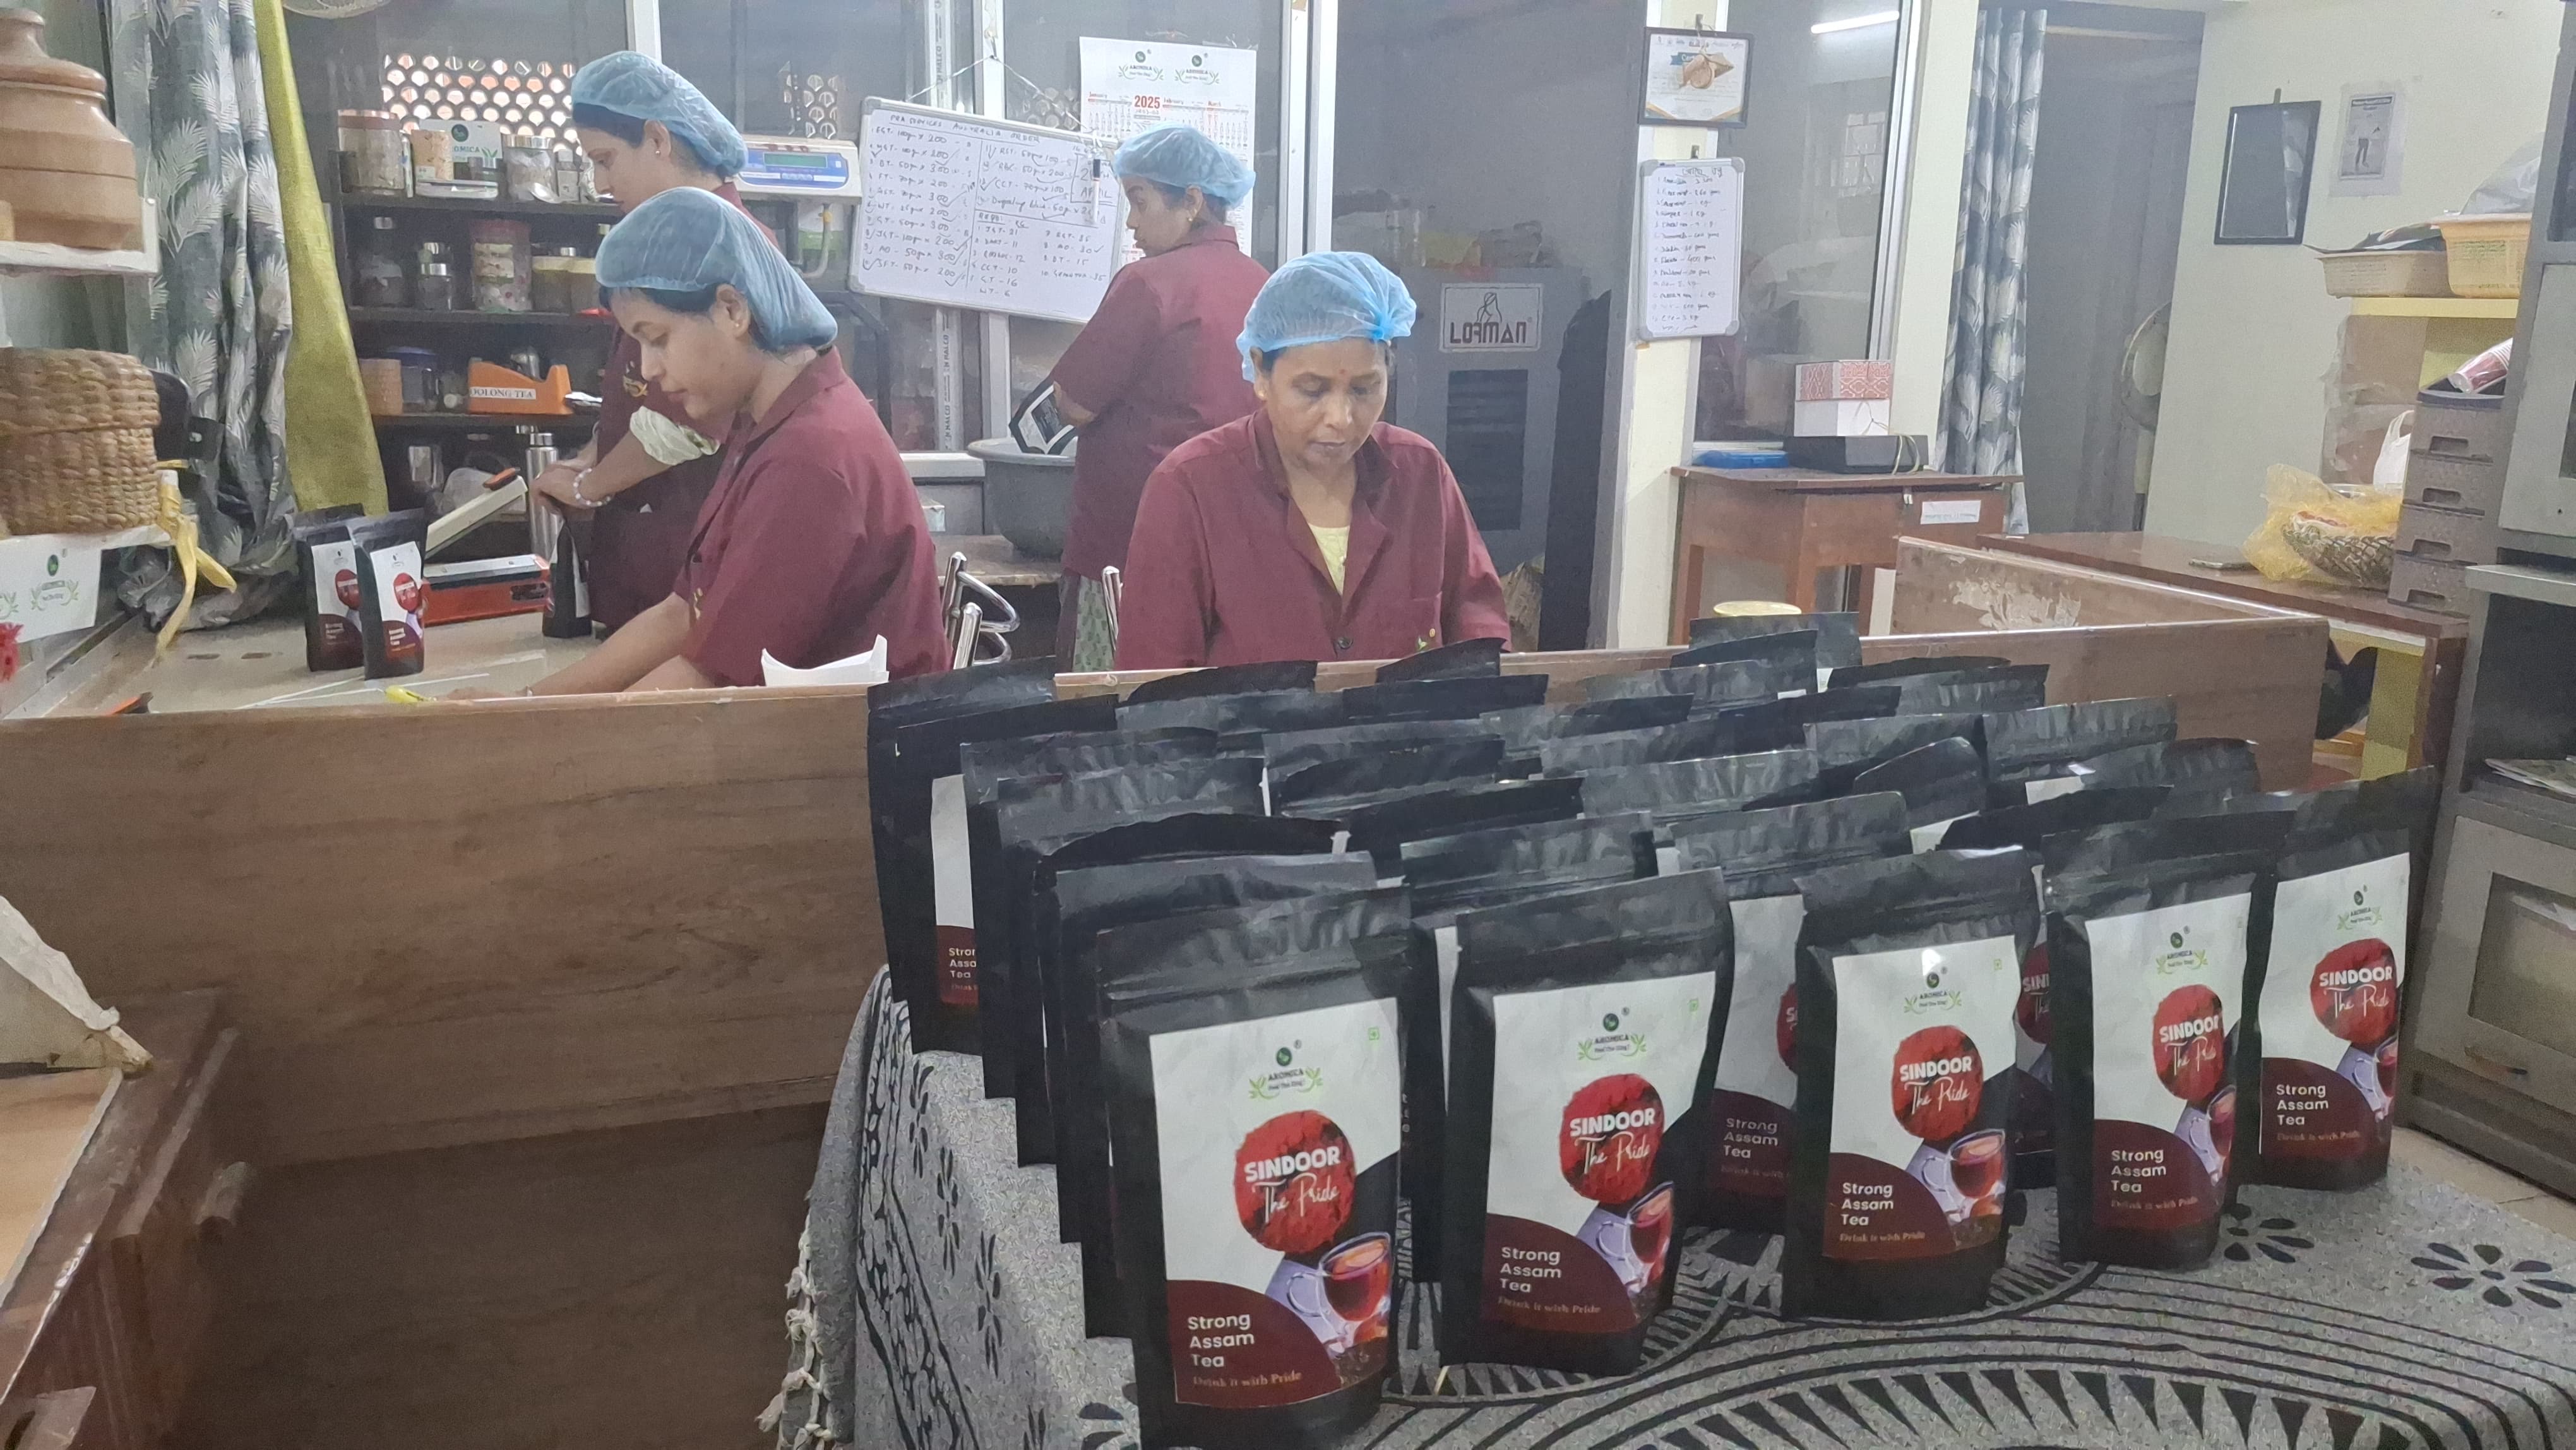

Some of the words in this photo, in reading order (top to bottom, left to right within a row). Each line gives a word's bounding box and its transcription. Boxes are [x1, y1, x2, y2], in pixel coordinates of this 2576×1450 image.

[1135, 95, 1160, 109] 2025
[1450, 321, 1527, 344] LORMAN
[515, 390, 533, 398] TEA
[948, 947, 975, 957] Stro
[950, 959, 977, 968] Assa
[950, 970, 972, 979] Tea
[2319, 966, 2393, 987] SINDOOR
[2323, 985, 2354, 1019] The
[2164, 1041, 2190, 1076] The
[1899, 1056, 1973, 1082] SINDOOR
[1904, 1080, 1932, 1115] The
[1934, 1076, 1970, 1111] Pride
[2276, 1084, 2326, 1098] Strong
[2277, 1099, 2329, 1111] Assam
[1570, 1108, 1655, 1137] SINDOOR
[1726, 1117, 1778, 1134] Strong
[2277, 1115, 2305, 1125] Tea
[1724, 1131, 1779, 1147] Assam
[1574, 1135, 1608, 1175] The
[1611, 1130, 1651, 1173] Pride
[1724, 1145, 1751, 1159] Tea
[2111, 1149, 2164, 1163] Strong
[1244, 1145, 1341, 1183] SINDOOR
[2111, 1165, 2167, 1177] Assam
[1842, 1182, 1893, 1199] Strong
[2111, 1180, 2142, 1193] Tea
[1251, 1178, 1289, 1224] The
[1292, 1172, 1339, 1218] Pride
[1841, 1199, 1894, 1211] Assam
[1841, 1214, 1869, 1226] Tea
[1501, 1246, 1561, 1266] Strong
[1500, 1262, 1561, 1279] Assam
[1500, 1278, 1532, 1293] Tea
[1544, 1303, 1570, 1314] with
[1572, 1304, 1602, 1315] Pride
[1188, 1314, 1251, 1331] Strong
[1190, 1333, 1255, 1349] Assam
[1191, 1353, 1225, 1368] Tea
[1241, 1373, 1268, 1387] with
[1270, 1369, 1303, 1387] Pride
